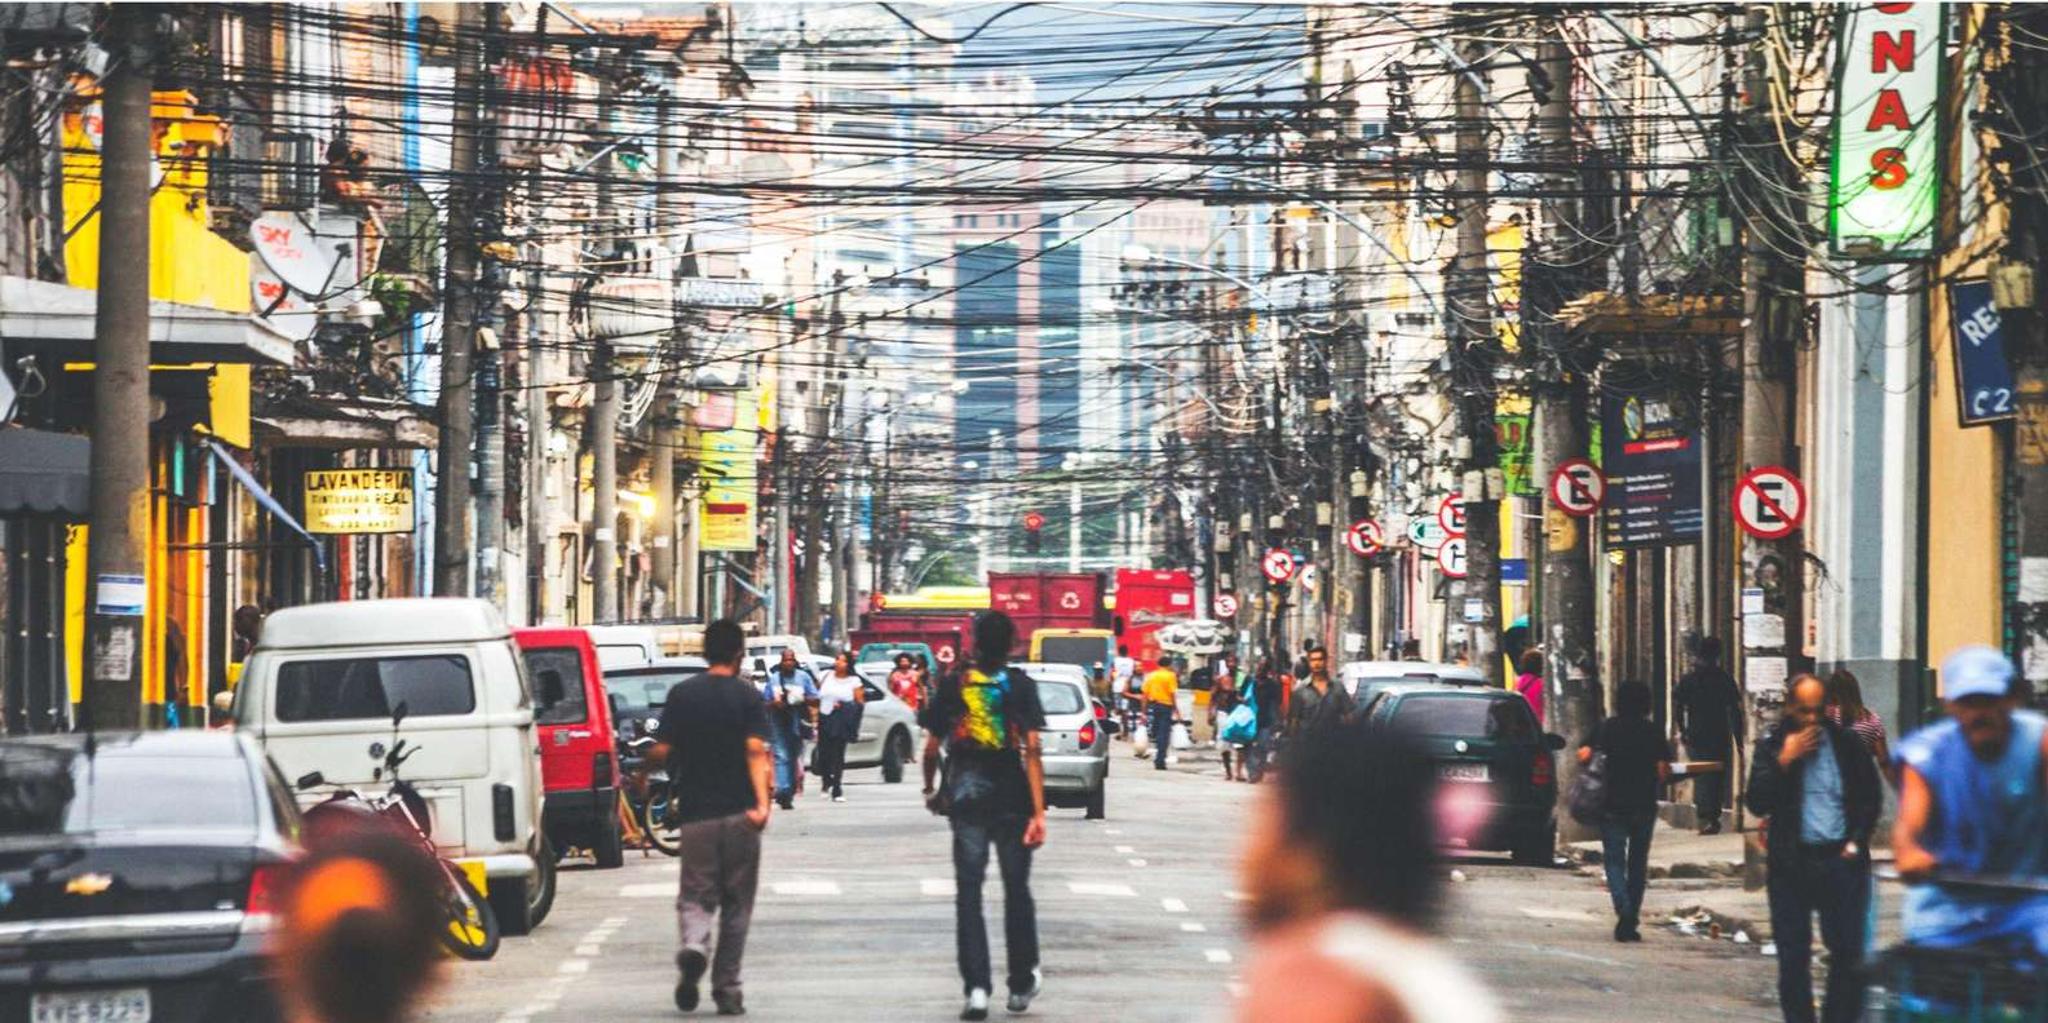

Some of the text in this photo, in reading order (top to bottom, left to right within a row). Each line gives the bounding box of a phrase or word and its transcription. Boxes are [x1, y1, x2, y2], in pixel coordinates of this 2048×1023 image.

[307, 472, 411, 491] LAVANDERIA
[1569, 471, 1590, 504] E
[375, 492, 409, 505] REAL
[1757, 482, 1783, 523] E
